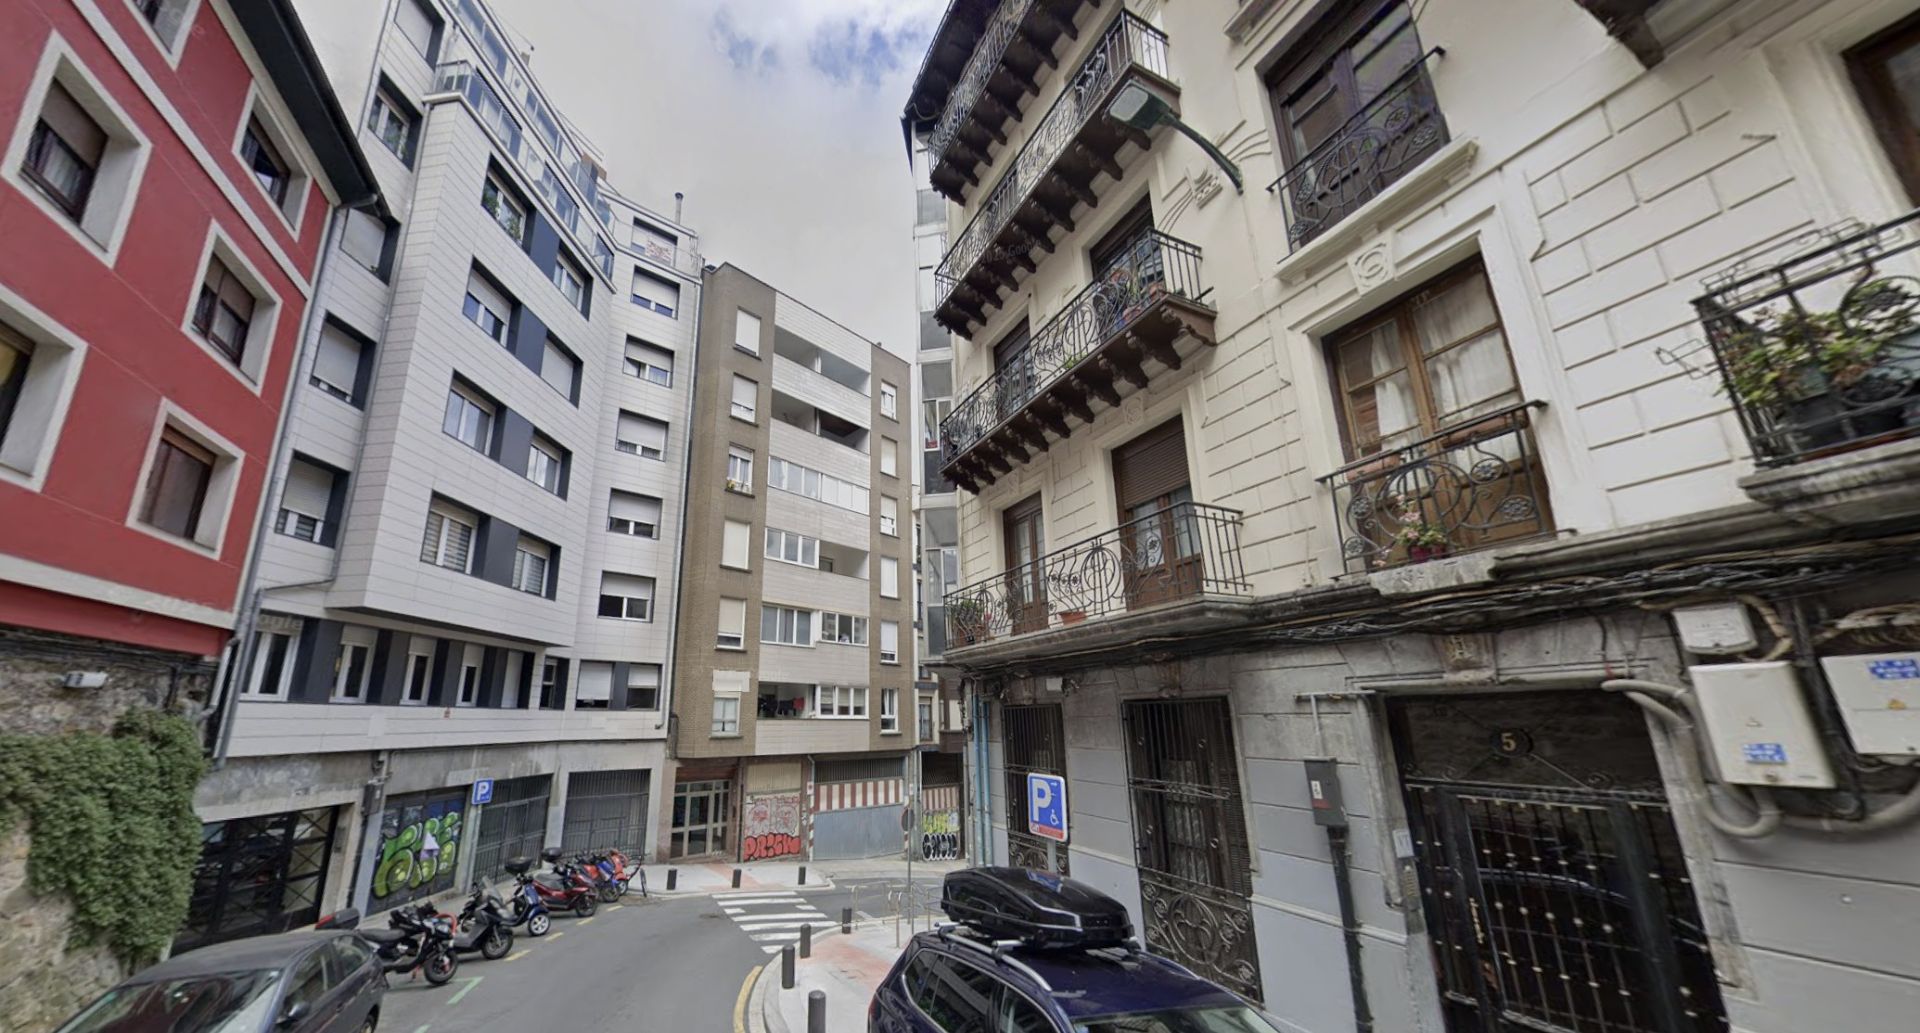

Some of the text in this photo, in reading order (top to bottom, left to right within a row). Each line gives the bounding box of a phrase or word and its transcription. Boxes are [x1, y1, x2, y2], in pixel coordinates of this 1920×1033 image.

[1501, 732, 1517, 751] 5
[476, 782, 490, 801] P
[1031, 778, 1052, 822] P
